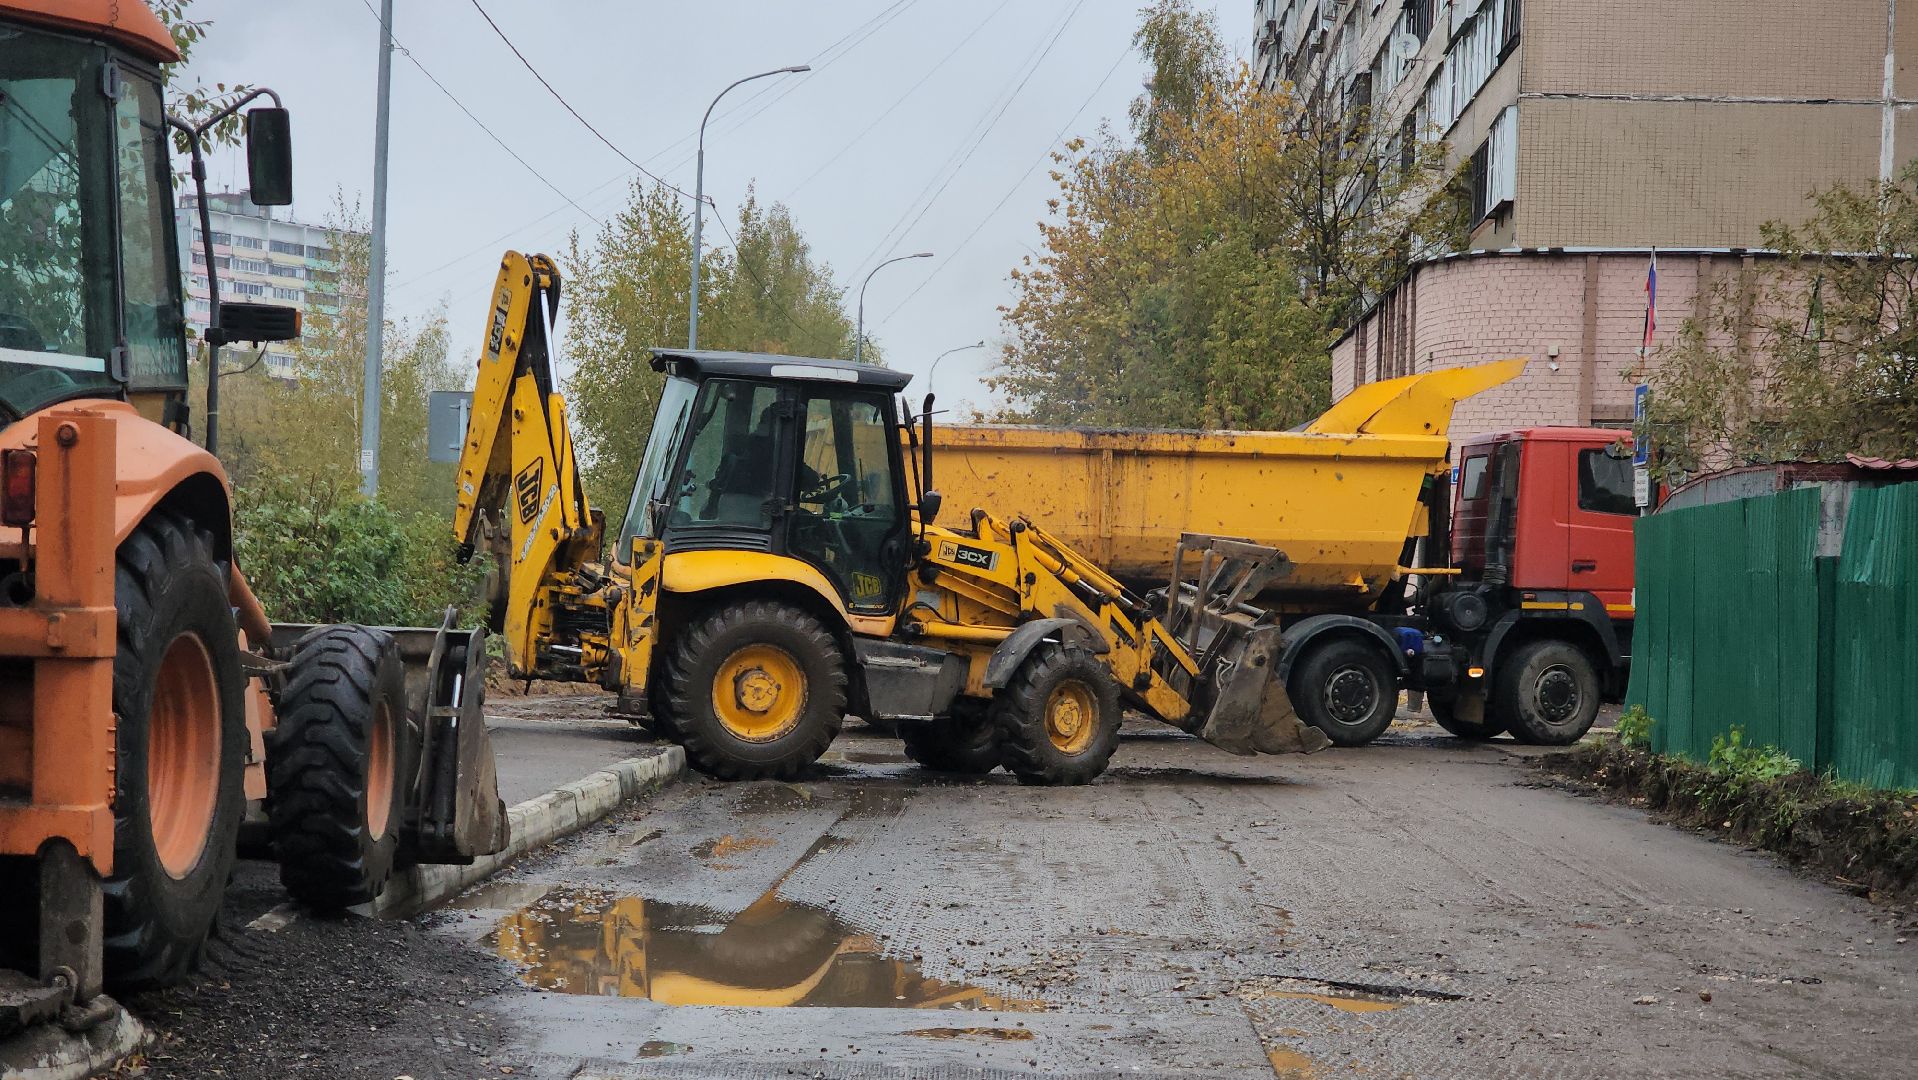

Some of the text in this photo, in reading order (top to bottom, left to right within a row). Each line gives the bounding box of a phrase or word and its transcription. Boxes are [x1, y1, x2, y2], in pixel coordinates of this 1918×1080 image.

[517, 467, 540, 519] JCB
[957, 550, 988, 564] 3CX
[855, 574, 880, 598] JCB
